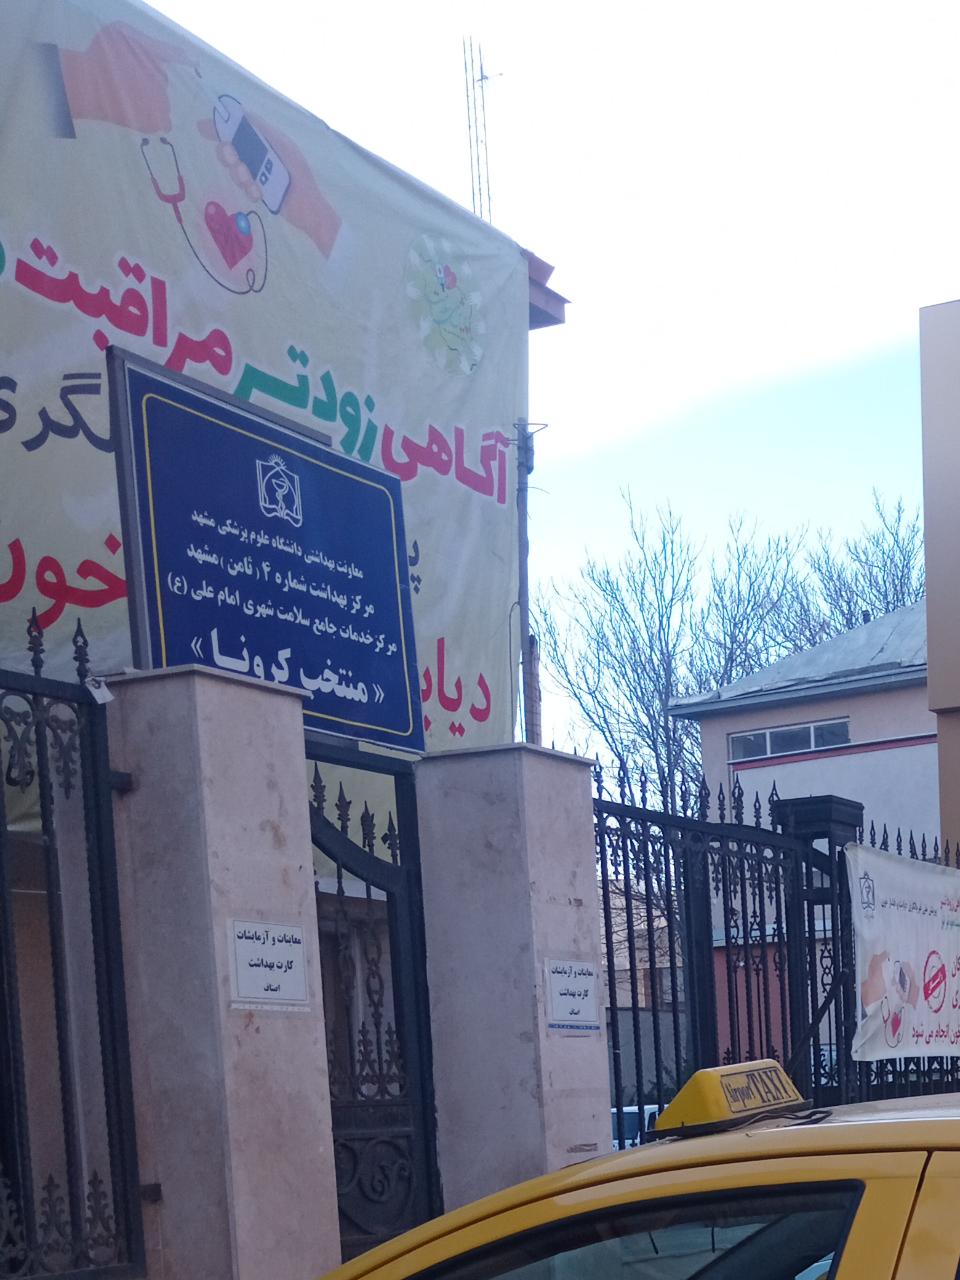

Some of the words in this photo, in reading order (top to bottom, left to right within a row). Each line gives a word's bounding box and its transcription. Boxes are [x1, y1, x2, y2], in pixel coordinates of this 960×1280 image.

[14, 238, 233, 376] مراقبت
[233, 346, 378, 461] زودتر
[381, 424, 507, 504] آگاهی
[191, 509, 216, 528] مشهد
[218, 519, 250, 544] پزشکی
[250, 530, 270, 547] علوم
[187, 543, 219, 565] مشهد
[272, 535, 302, 557] دانشگاه
[304, 549, 336, 567] بهداشتی
[275, 570, 308, 592] شماره
[336, 563, 364, 580] معاونت
[168, 572, 188, 596] (ع)
[191, 579, 215, 601] علی
[217, 586, 240, 607] امام
[309, 582, 348, 610] بهداشت
[351, 595, 375, 618] مرکز
[243, 599, 275, 618] شهری
[277, 605, 311, 627] سلامت
[312, 617, 338, 640] جامع
[339, 625, 375, 645] خدمات
[375, 633, 398, 655] مرکز
[271, 936, 276, 945] و
[277, 933, 302, 946] معاینات
[248, 957, 275, 971] بهداشت
[276, 960, 294, 973] کارت
[746, 1069, 792, 1103] TAXI
